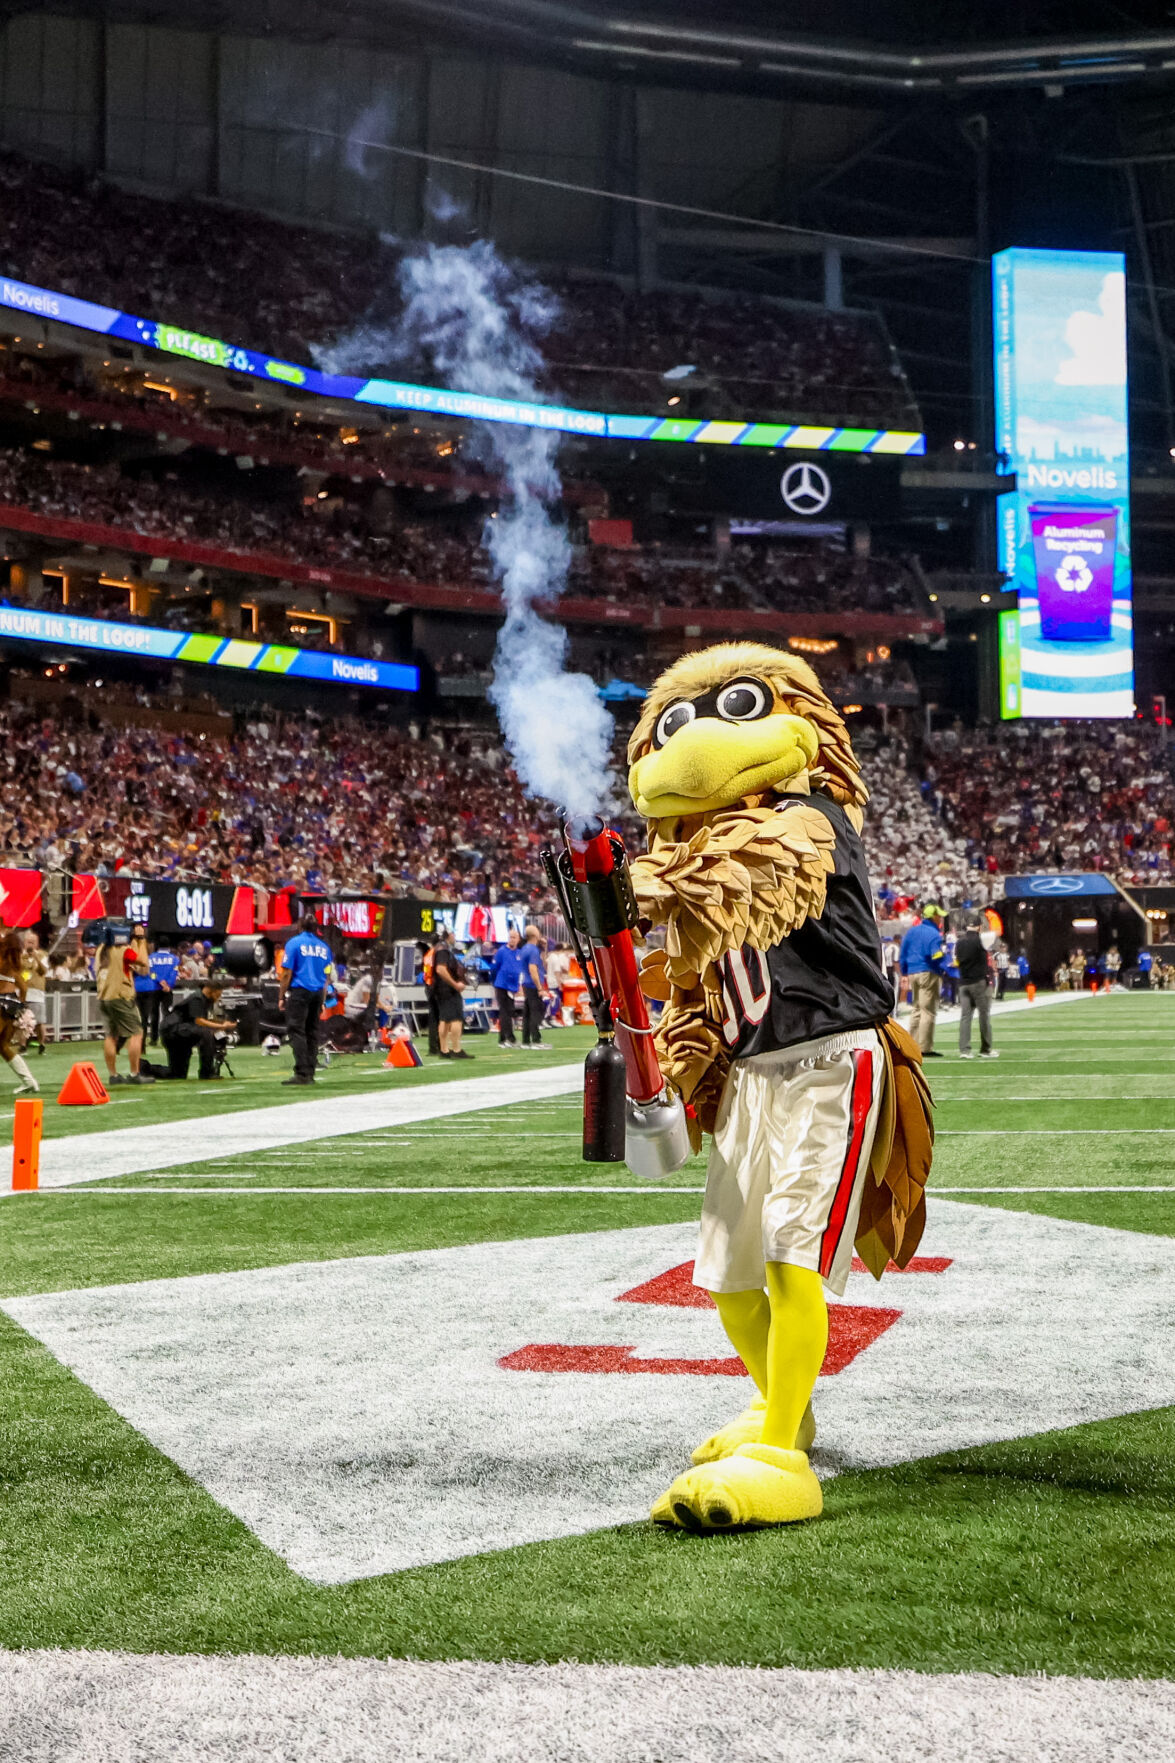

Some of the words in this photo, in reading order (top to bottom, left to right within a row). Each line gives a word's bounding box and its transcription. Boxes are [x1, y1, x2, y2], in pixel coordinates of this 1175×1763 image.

[3, 283, 60, 315] Novelis
[166, 333, 217, 359] PLEASE
[396, 390, 431, 404] KEEP
[437, 396, 516, 419] ALUMINUM
[519, 408, 536, 422] IN
[539, 410, 564, 426] THE
[1027, 464, 1117, 489] Novelis
[1004, 509, 1016, 577] Novelis
[1043, 525, 1105, 539] Aluminum
[1045, 538, 1103, 554] Recycling
[45, 621, 64, 638] IN
[69, 622, 98, 643] THE
[103, 629, 150, 649] LOOP!
[332, 659, 379, 682] Novelis
[125, 896, 151, 921] 1ST
[176, 886, 214, 928] 8:01
